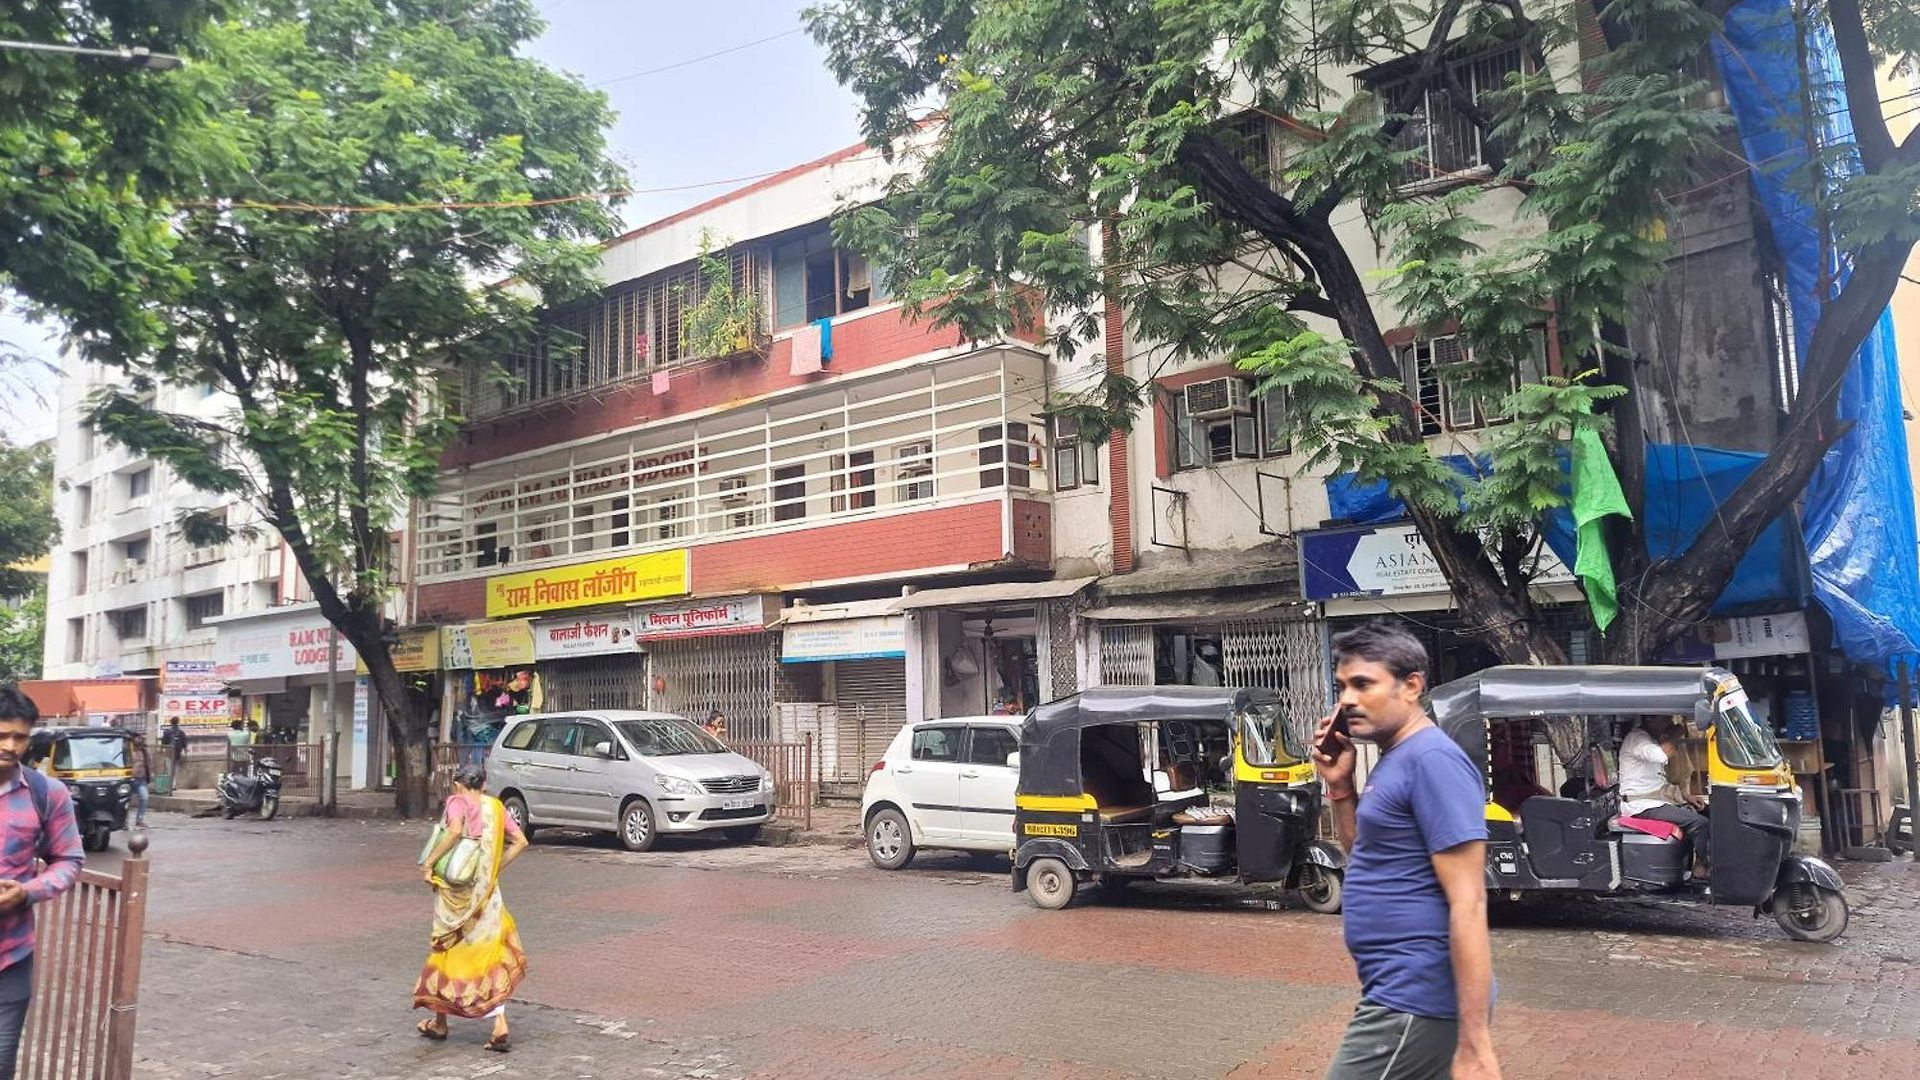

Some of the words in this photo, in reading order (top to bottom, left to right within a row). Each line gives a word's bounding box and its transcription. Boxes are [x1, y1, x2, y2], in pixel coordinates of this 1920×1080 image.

[506, 586, 532, 608] राम
[534, 578, 580, 605] निवास
[649, 613, 680, 625] मिलन
[295, 646, 344, 666] LODGIG
